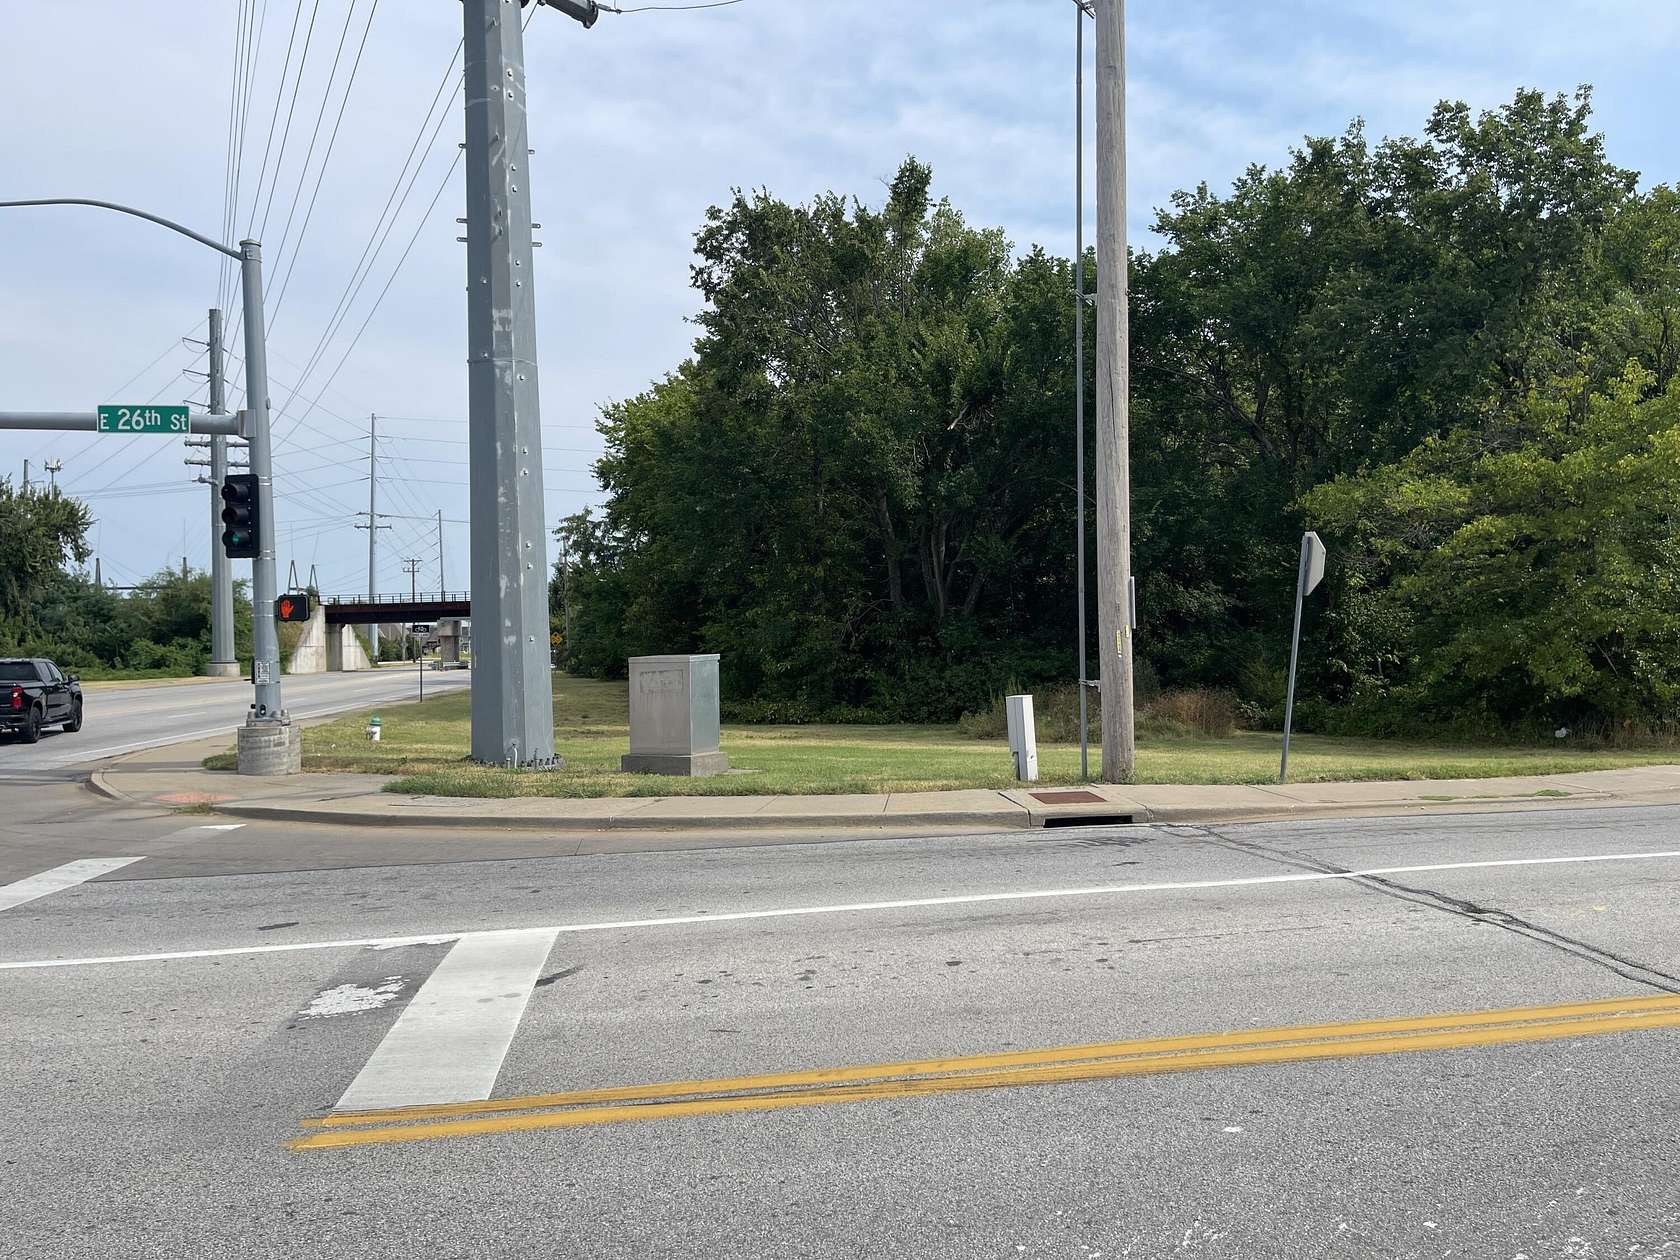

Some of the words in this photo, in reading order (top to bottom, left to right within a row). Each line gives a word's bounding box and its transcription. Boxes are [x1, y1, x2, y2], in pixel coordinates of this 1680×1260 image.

[100, 413, 109, 430] E
[117, 408, 161, 430] 26th
[170, 413, 187, 430] St
